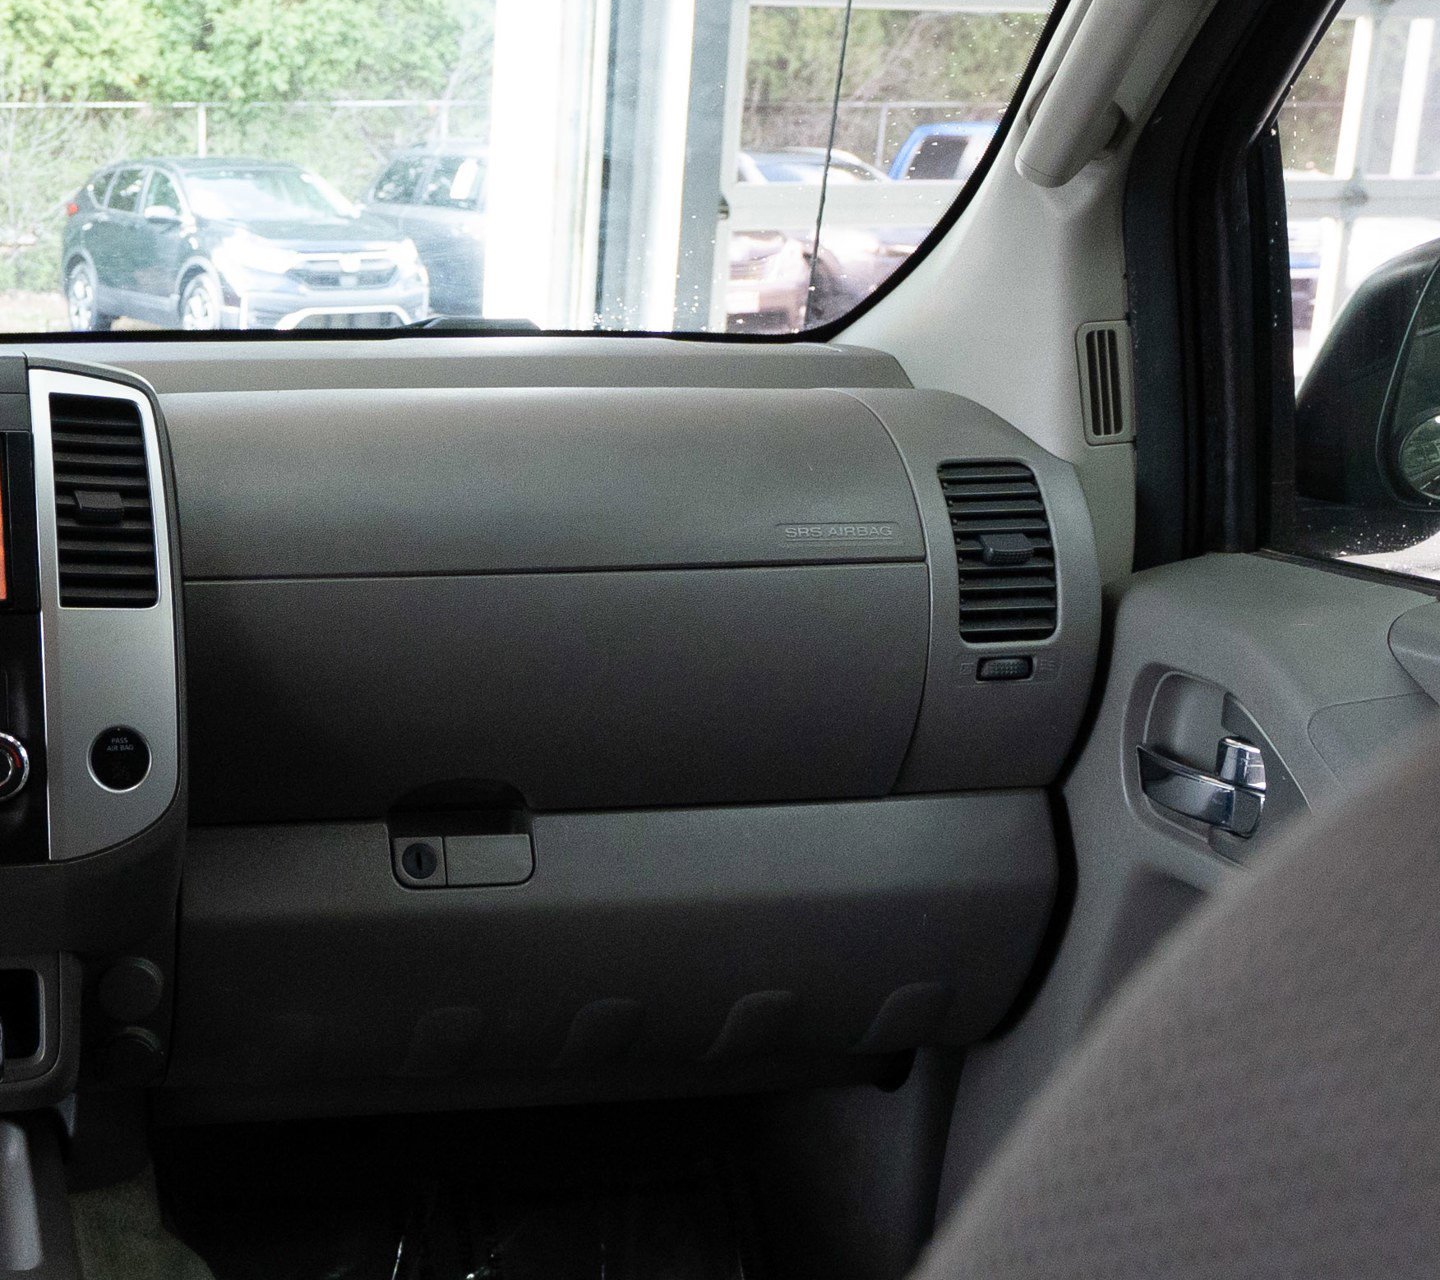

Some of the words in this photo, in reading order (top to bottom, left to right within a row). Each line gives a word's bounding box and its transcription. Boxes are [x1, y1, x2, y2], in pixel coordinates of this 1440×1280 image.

[785, 526, 822, 538] SRS
[828, 525, 893, 538] AIRBAG
[110, 736, 129, 745] PASS
[106, 744, 119, 752] AIR
[119, 743, 135, 752] BAG
